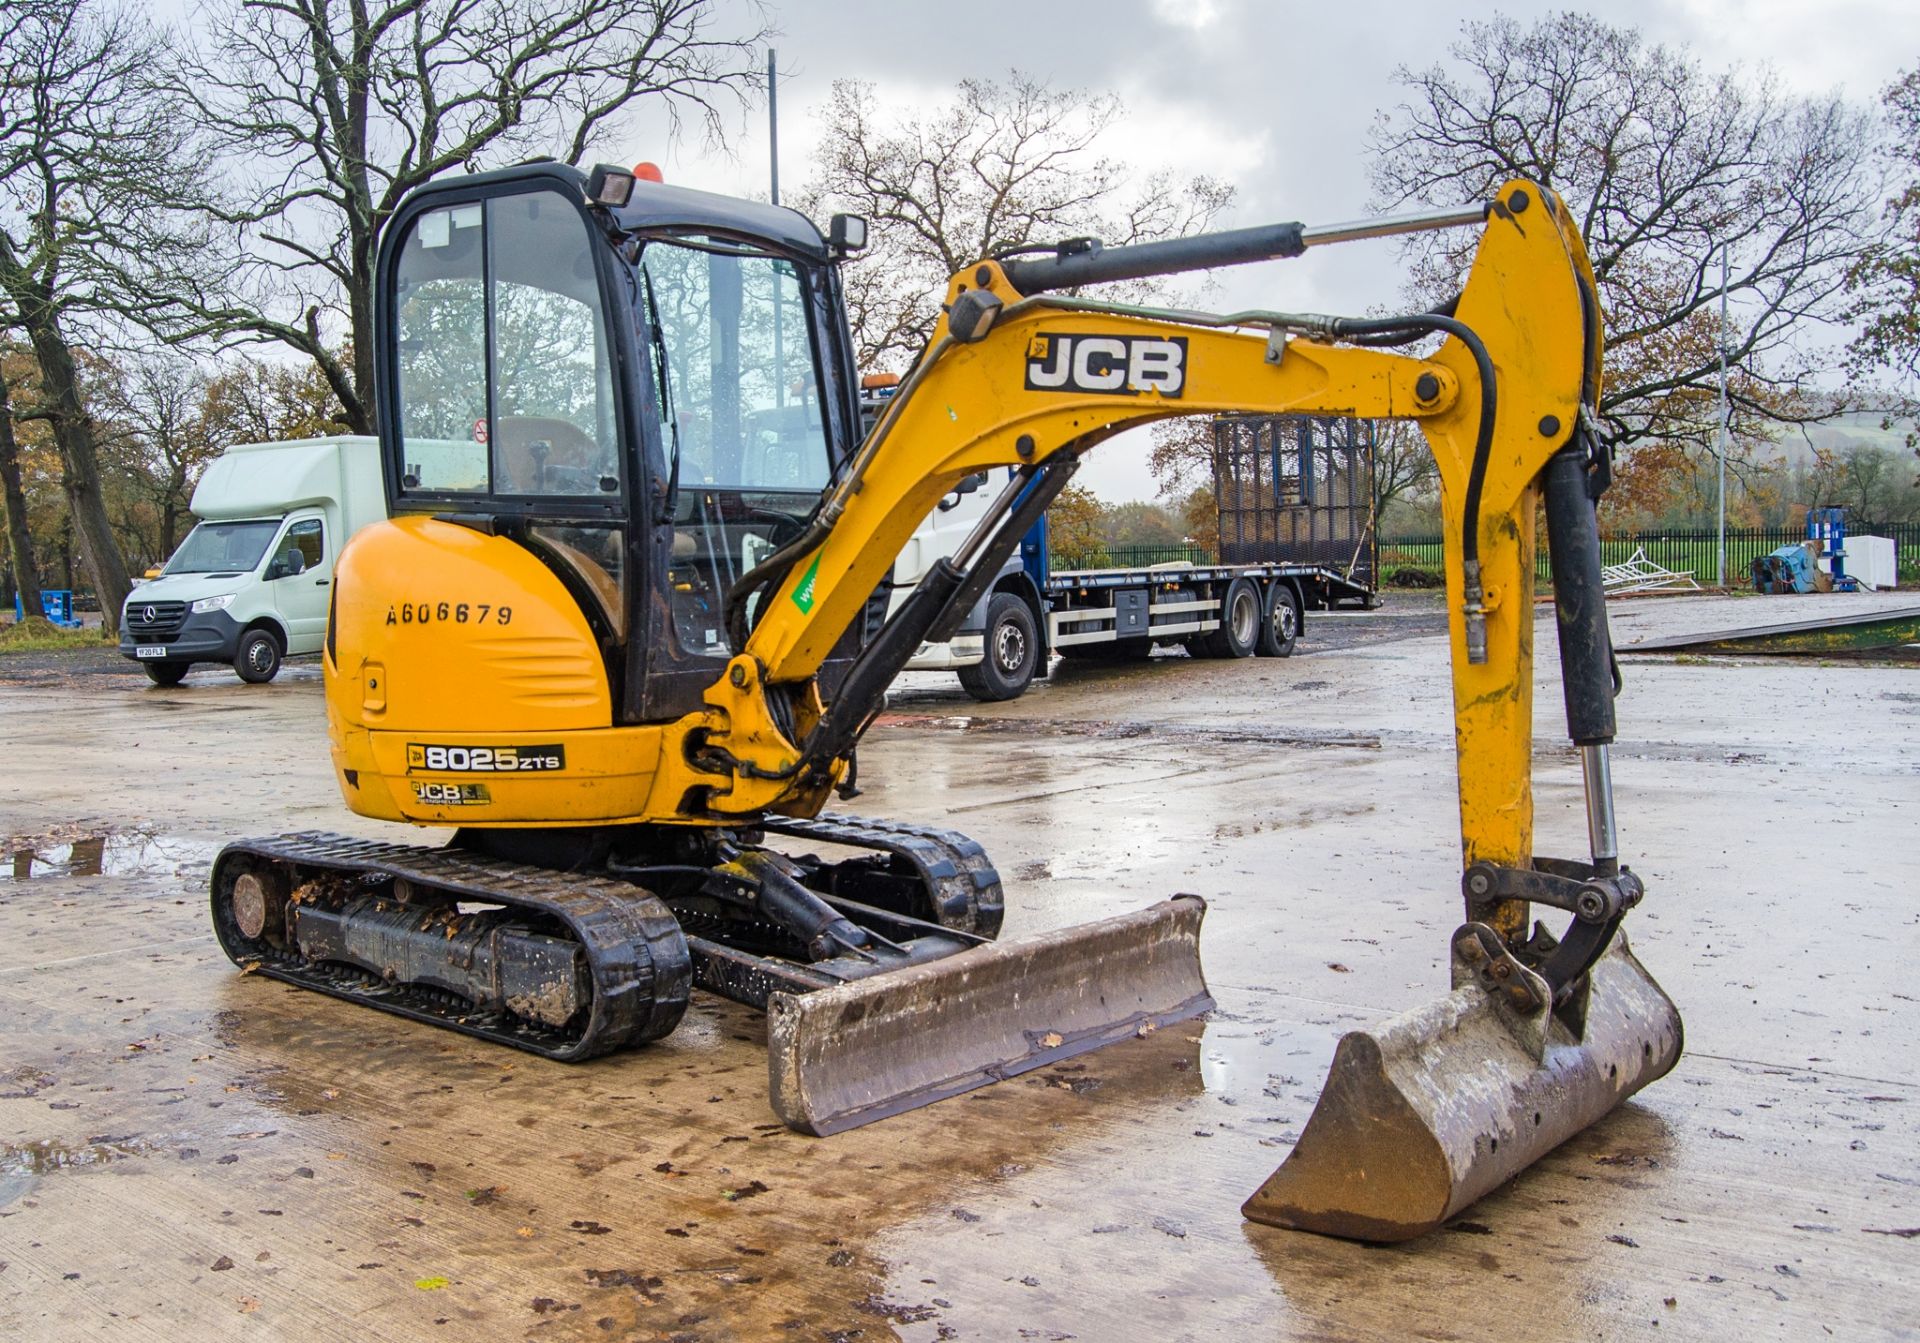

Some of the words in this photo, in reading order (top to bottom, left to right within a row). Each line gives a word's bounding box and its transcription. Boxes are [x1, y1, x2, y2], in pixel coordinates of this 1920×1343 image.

[1029, 338, 1183, 392] JCB
[386, 602, 512, 626] A606679
[417, 783, 461, 800] JCB
